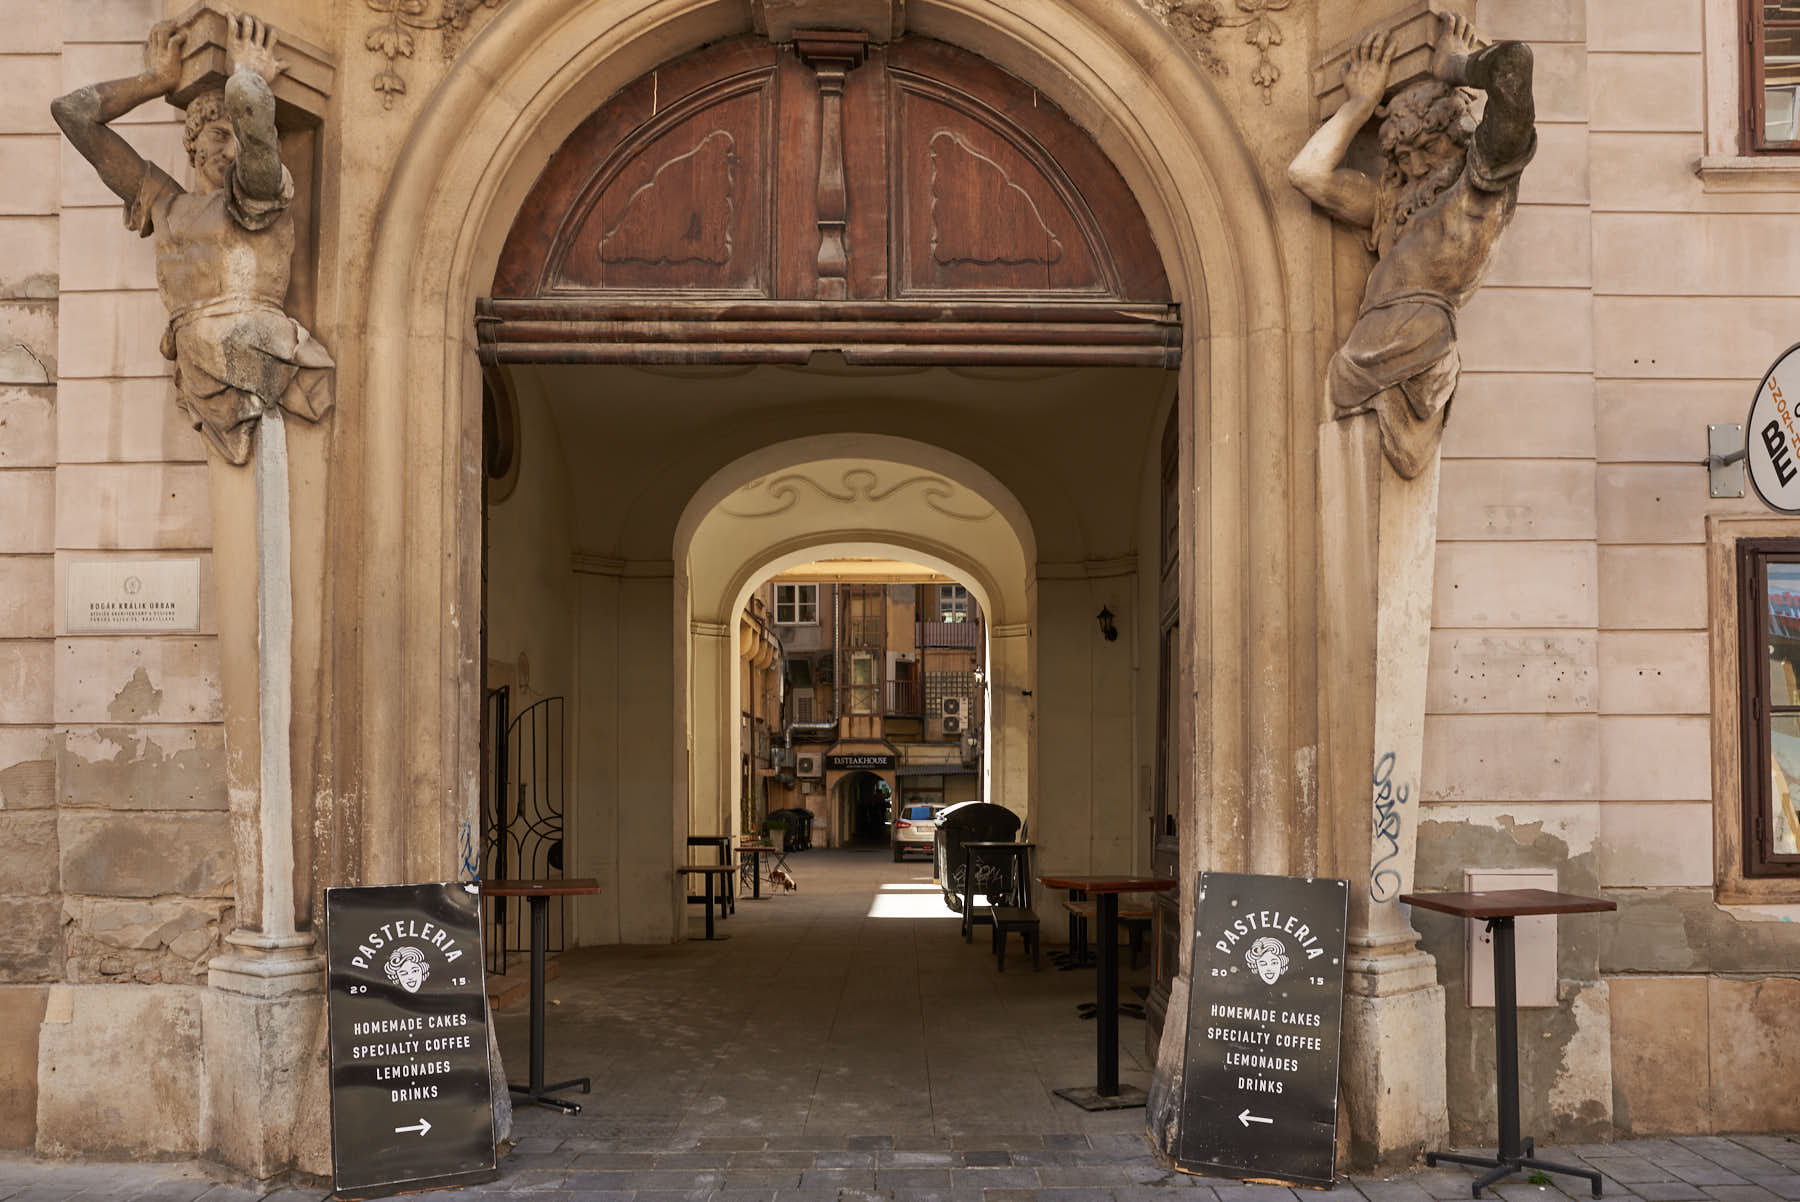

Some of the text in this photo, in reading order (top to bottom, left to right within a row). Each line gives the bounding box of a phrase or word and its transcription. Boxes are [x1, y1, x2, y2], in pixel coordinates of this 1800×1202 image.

[1761, 419, 1798, 488] BE
[352, 920, 462, 968] PASTELERIA
[1216, 911, 1323, 959] PASTELERIA
[351, 977, 466, 994] 20 15
[1212, 968, 1323, 985] 20 15
[354, 1014, 466, 1035] HOMEMADE CAKES
[1211, 1004, 1320, 1026] HOMEMADE CAKES
[353, 1036, 470, 1058] SPECIALTY COFFEE
[1208, 1026, 1321, 1050] SPECIALTY COFFEE
[377, 1061, 450, 1080] LEMONADES
[1227, 1053, 1297, 1071] LEMONADES
[392, 1086, 437, 1102] DRINKS
[1239, 1077, 1282, 1093] DRINKS
